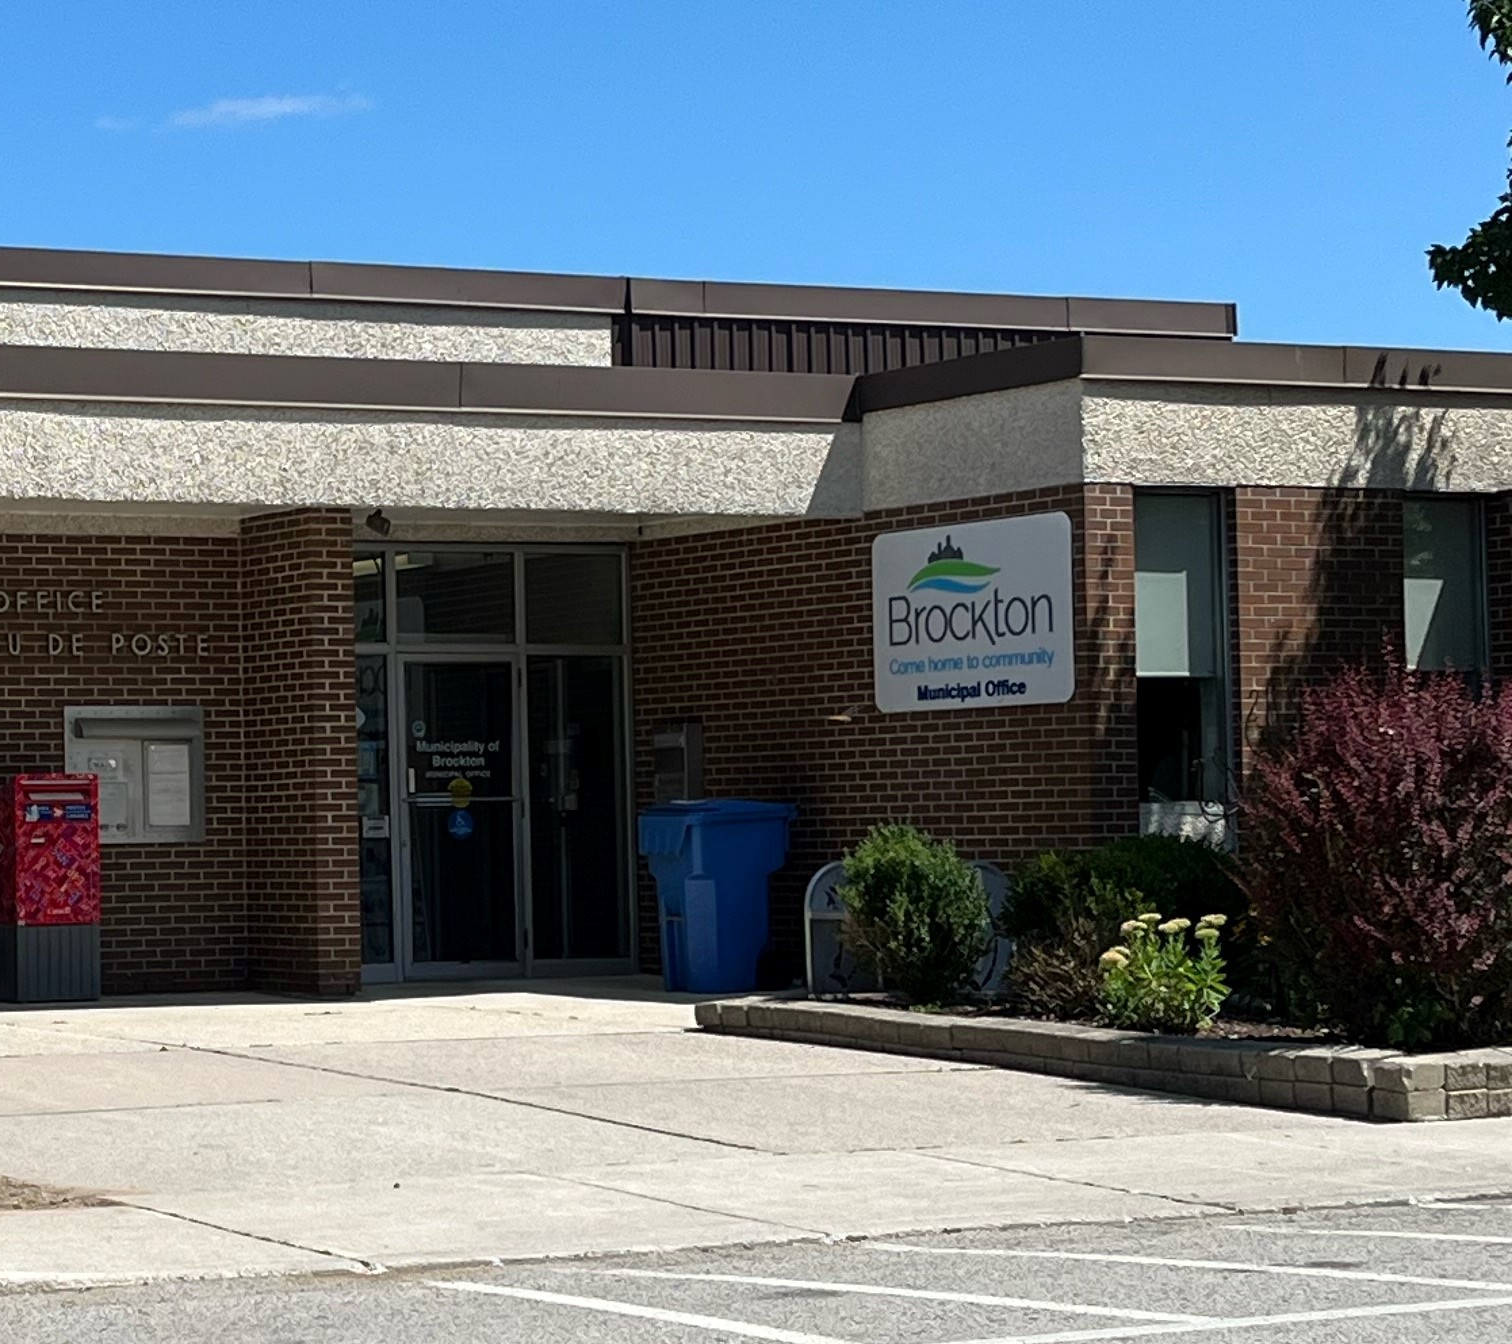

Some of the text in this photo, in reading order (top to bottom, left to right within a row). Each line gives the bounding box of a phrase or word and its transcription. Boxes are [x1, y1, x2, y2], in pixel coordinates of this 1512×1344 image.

[888, 587, 1054, 646] Brockton
[49, 633, 85, 656] DE
[112, 633, 210, 656] POSTE
[889, 647, 1055, 675] Come home to community
[917, 679, 1027, 702] Municipal Office
[416, 740, 500, 755] Municipality of
[432, 755, 485, 767] Brockton
